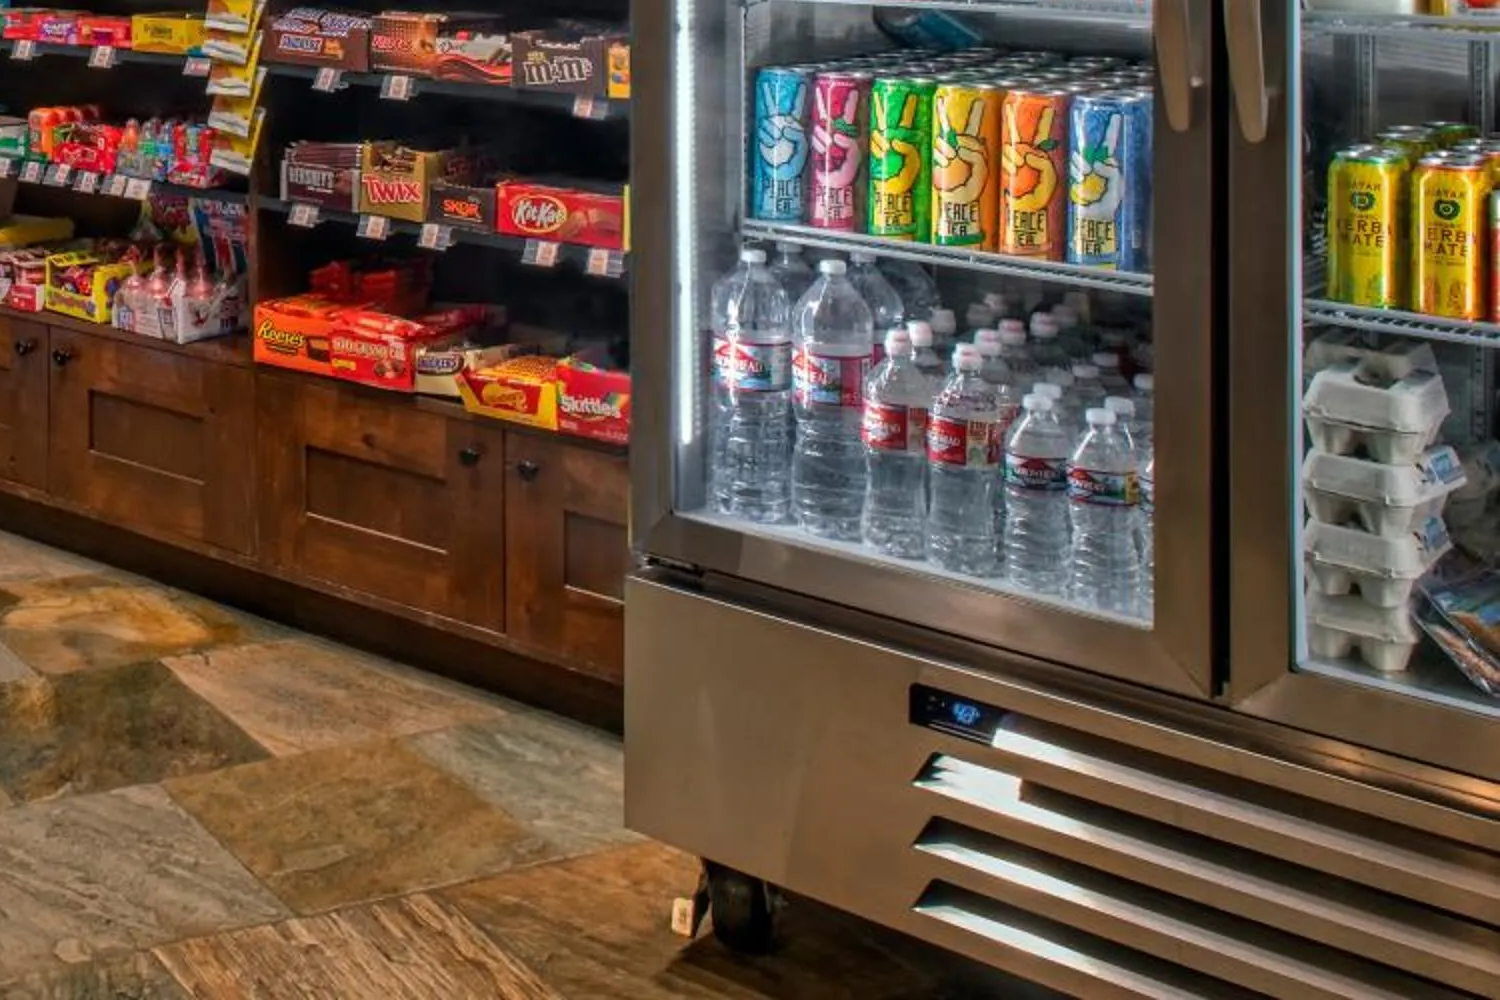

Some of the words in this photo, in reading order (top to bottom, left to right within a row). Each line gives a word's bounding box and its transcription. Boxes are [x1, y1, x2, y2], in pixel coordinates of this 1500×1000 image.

[945, 202, 978, 223] EACE
[1012, 209, 1046, 232] EACE
[1426, 227, 1476, 244] ERBA
[257, 319, 305, 348] Reese's
[559, 394, 622, 419] Skittles
